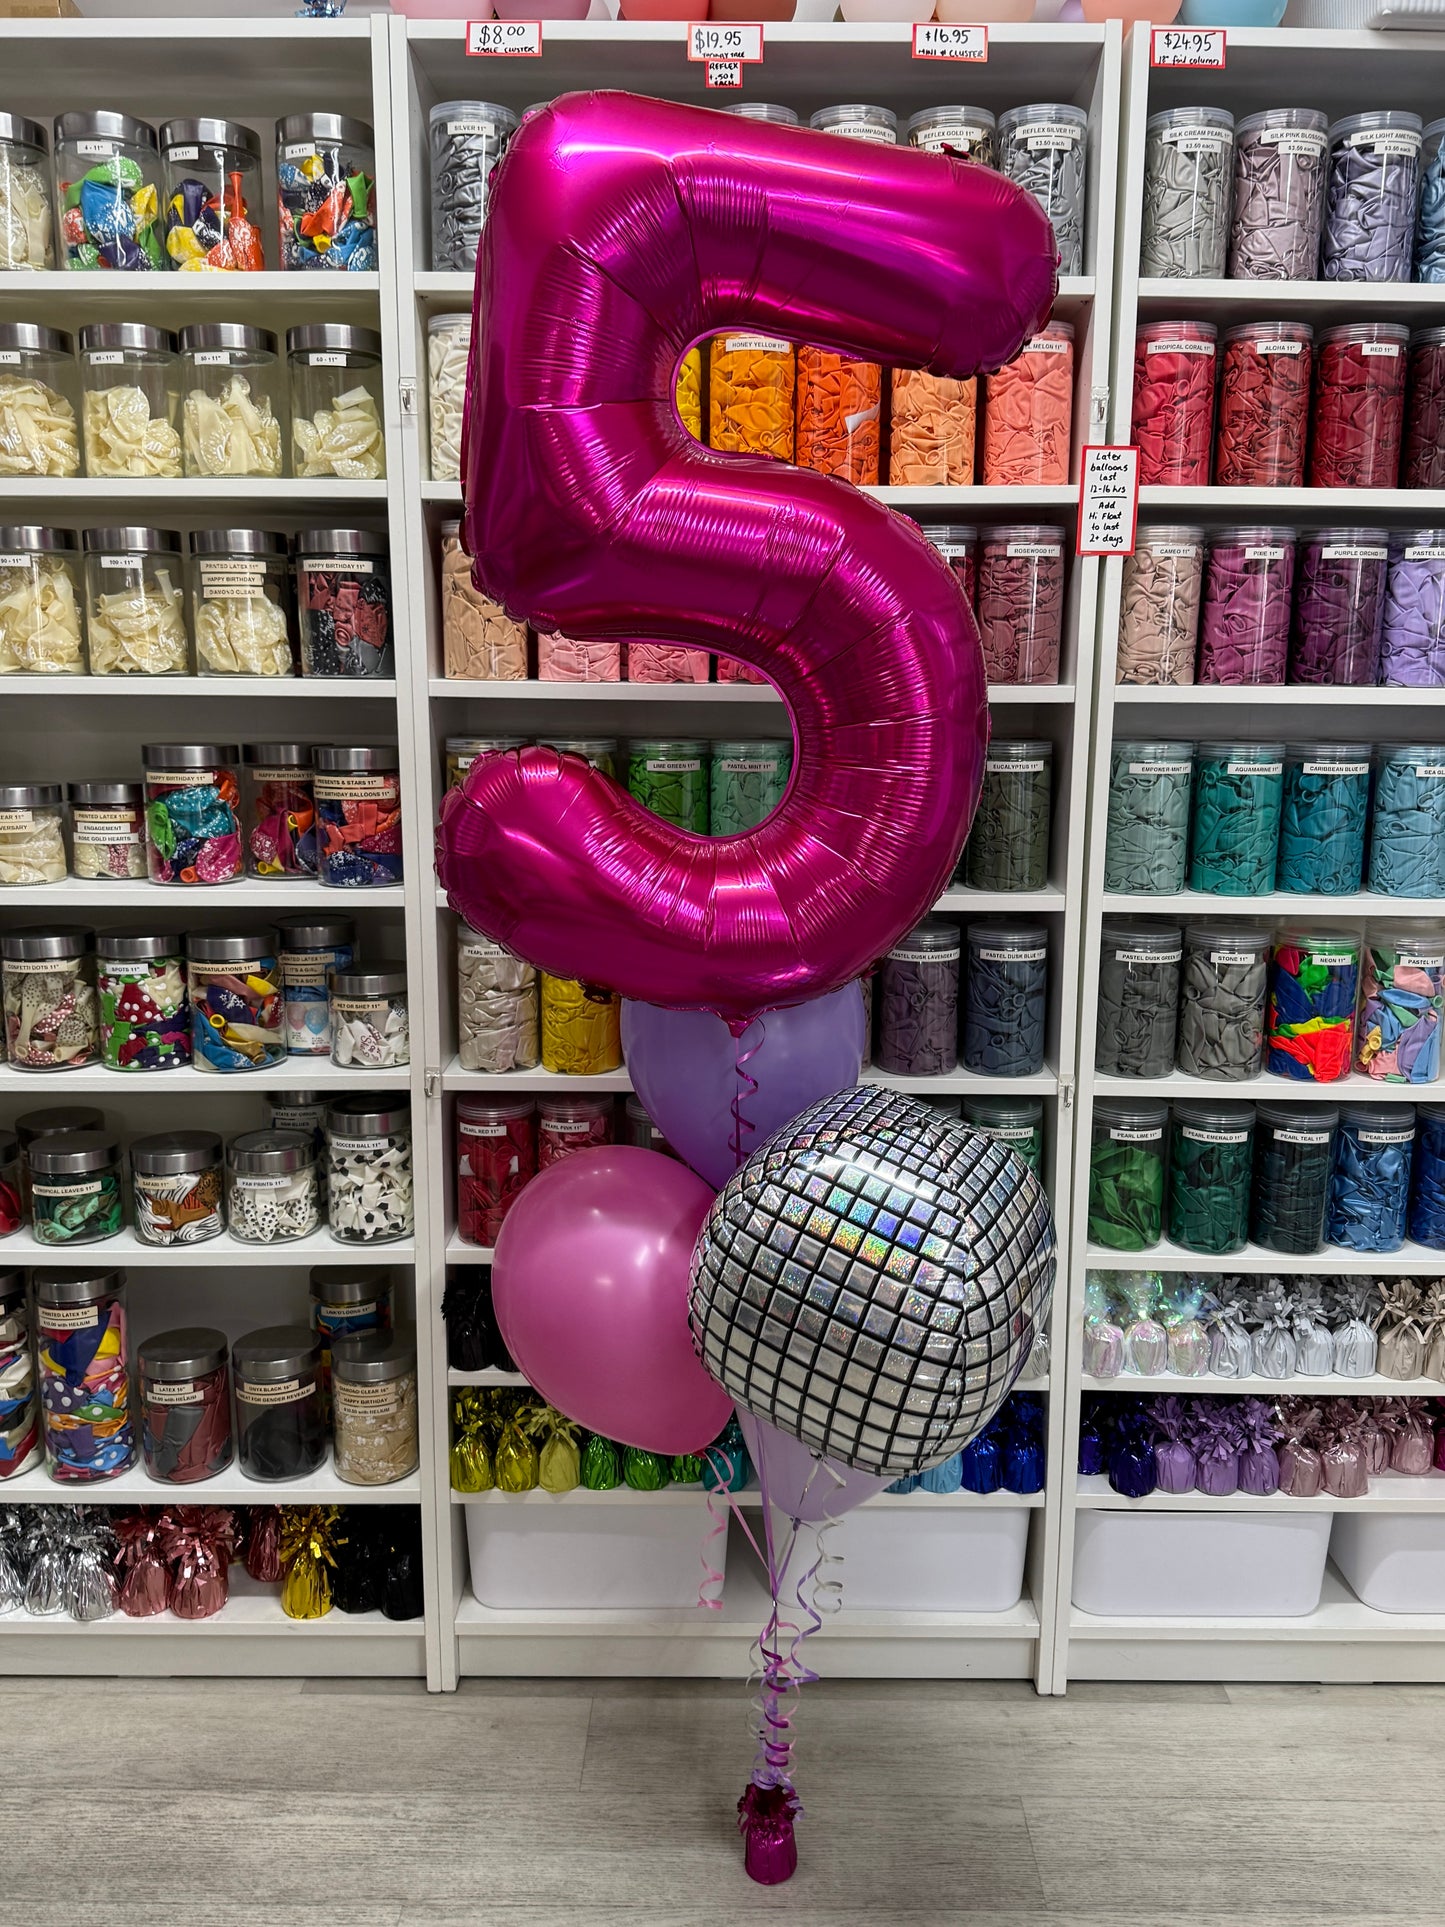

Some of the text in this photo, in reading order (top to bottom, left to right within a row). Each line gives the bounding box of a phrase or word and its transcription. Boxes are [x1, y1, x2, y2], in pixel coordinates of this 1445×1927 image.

[480, 25, 525, 46] $8.00
[925, 28, 971, 44] $16.95
[695, 28, 742, 54] $19.95
[1164, 32, 1216, 52] $24.95
[949, 50, 984, 58] CLUSTER
[1189, 55, 1220, 66] column
[709, 62, 738, 70] REFLEX
[1096, 451, 1121, 460] Latex
[1090, 463, 1128, 472] balloons
[1100, 472, 1117, 481] last
[1090, 485, 1126, 493] 12-16 hrs
[1098, 501, 1116, 509] Add
[1101, 511, 1122, 520] Float
[1091, 522, 1120, 531] to last
[1089, 534, 1123, 547] 2+ days
[1188, 1131, 1205, 1139] PEARL
[41, 1310, 61, 1318] PRINTED
